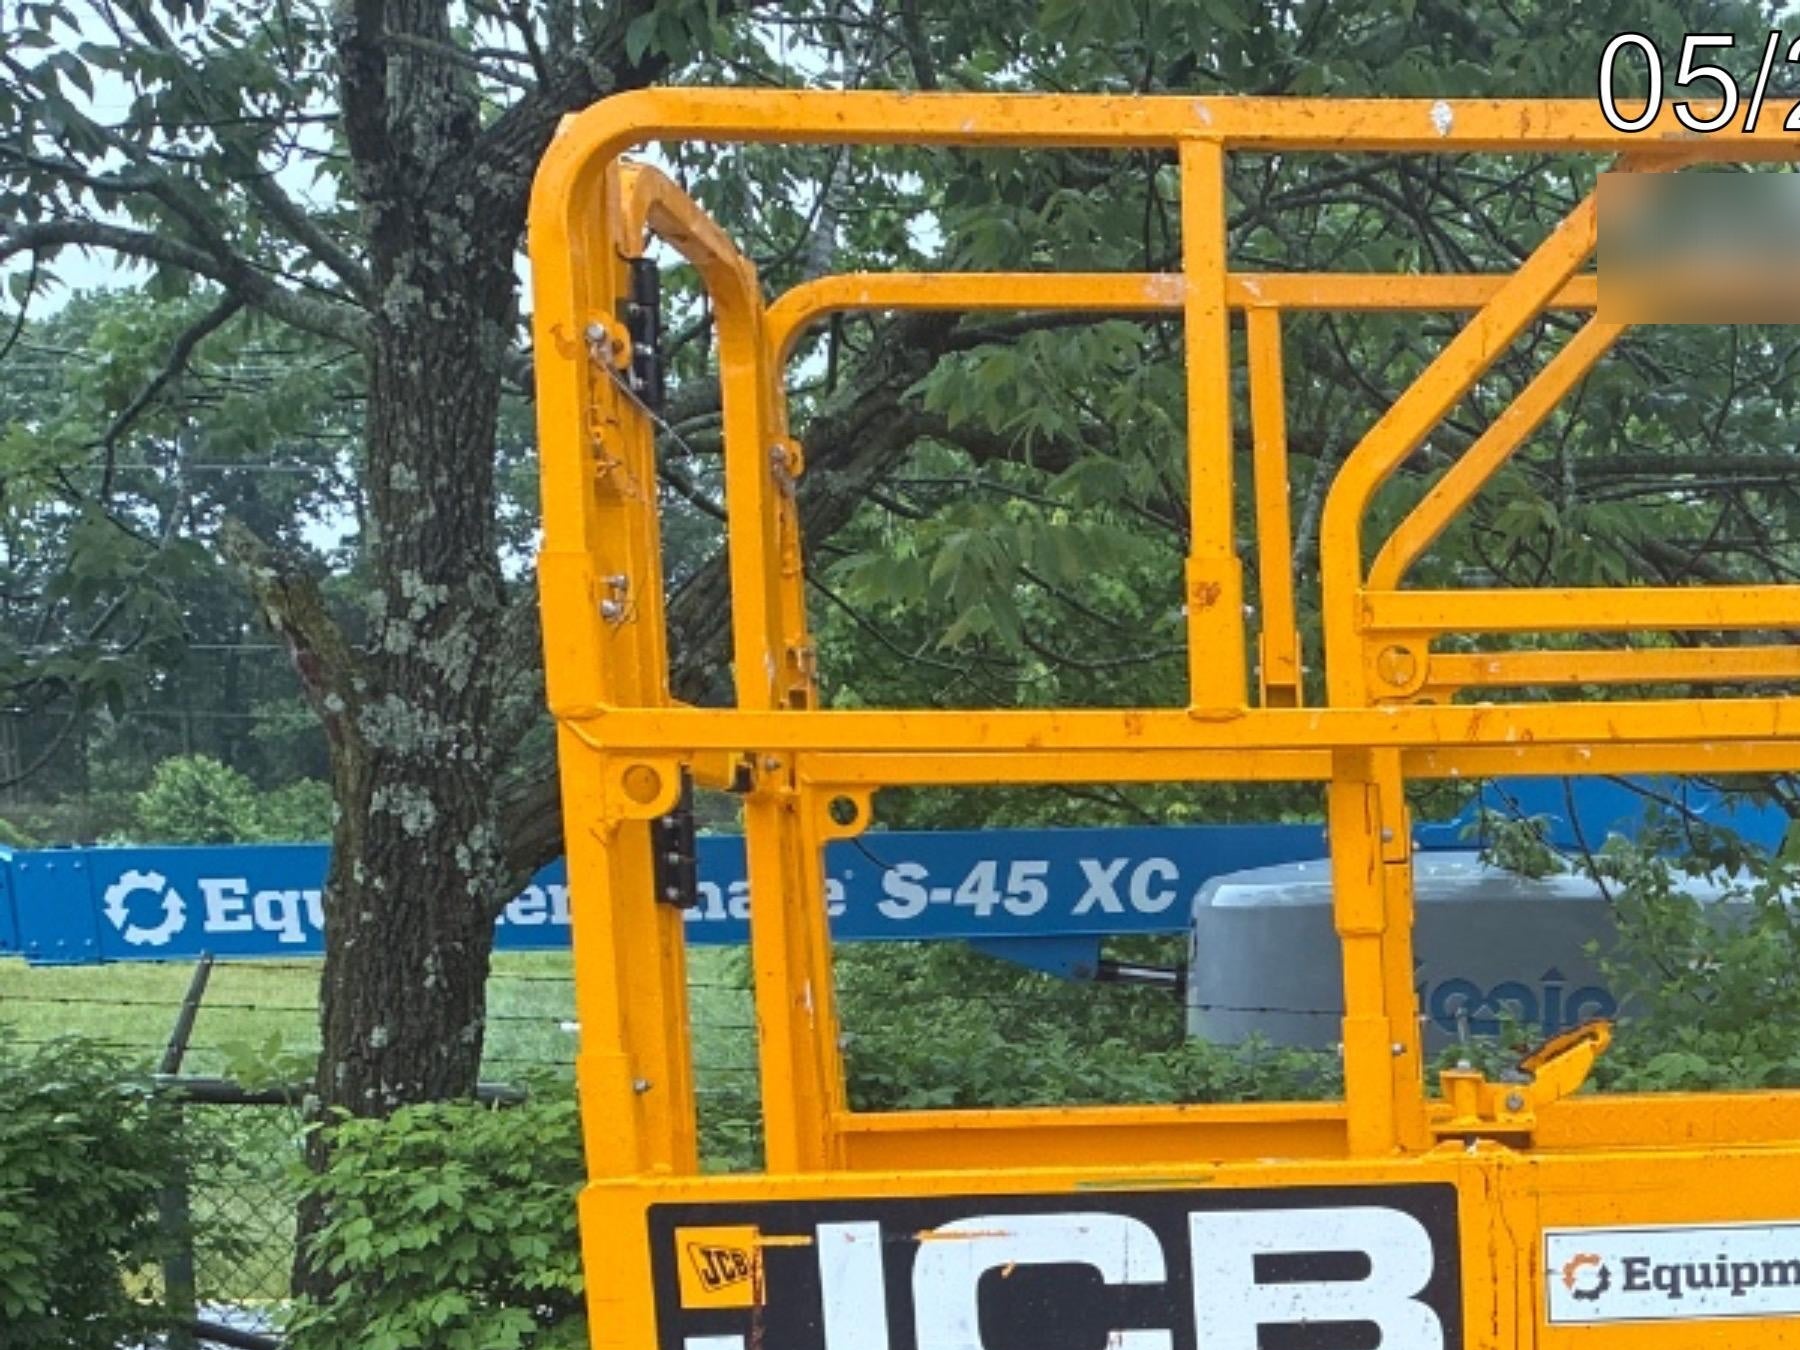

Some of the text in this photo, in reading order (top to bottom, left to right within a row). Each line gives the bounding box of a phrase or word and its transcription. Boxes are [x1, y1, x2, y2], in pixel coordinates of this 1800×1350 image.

[876, 859, 1050, 919] S-45
[1070, 856, 1180, 914] XC
[700, 1249, 749, 1285] JCB
